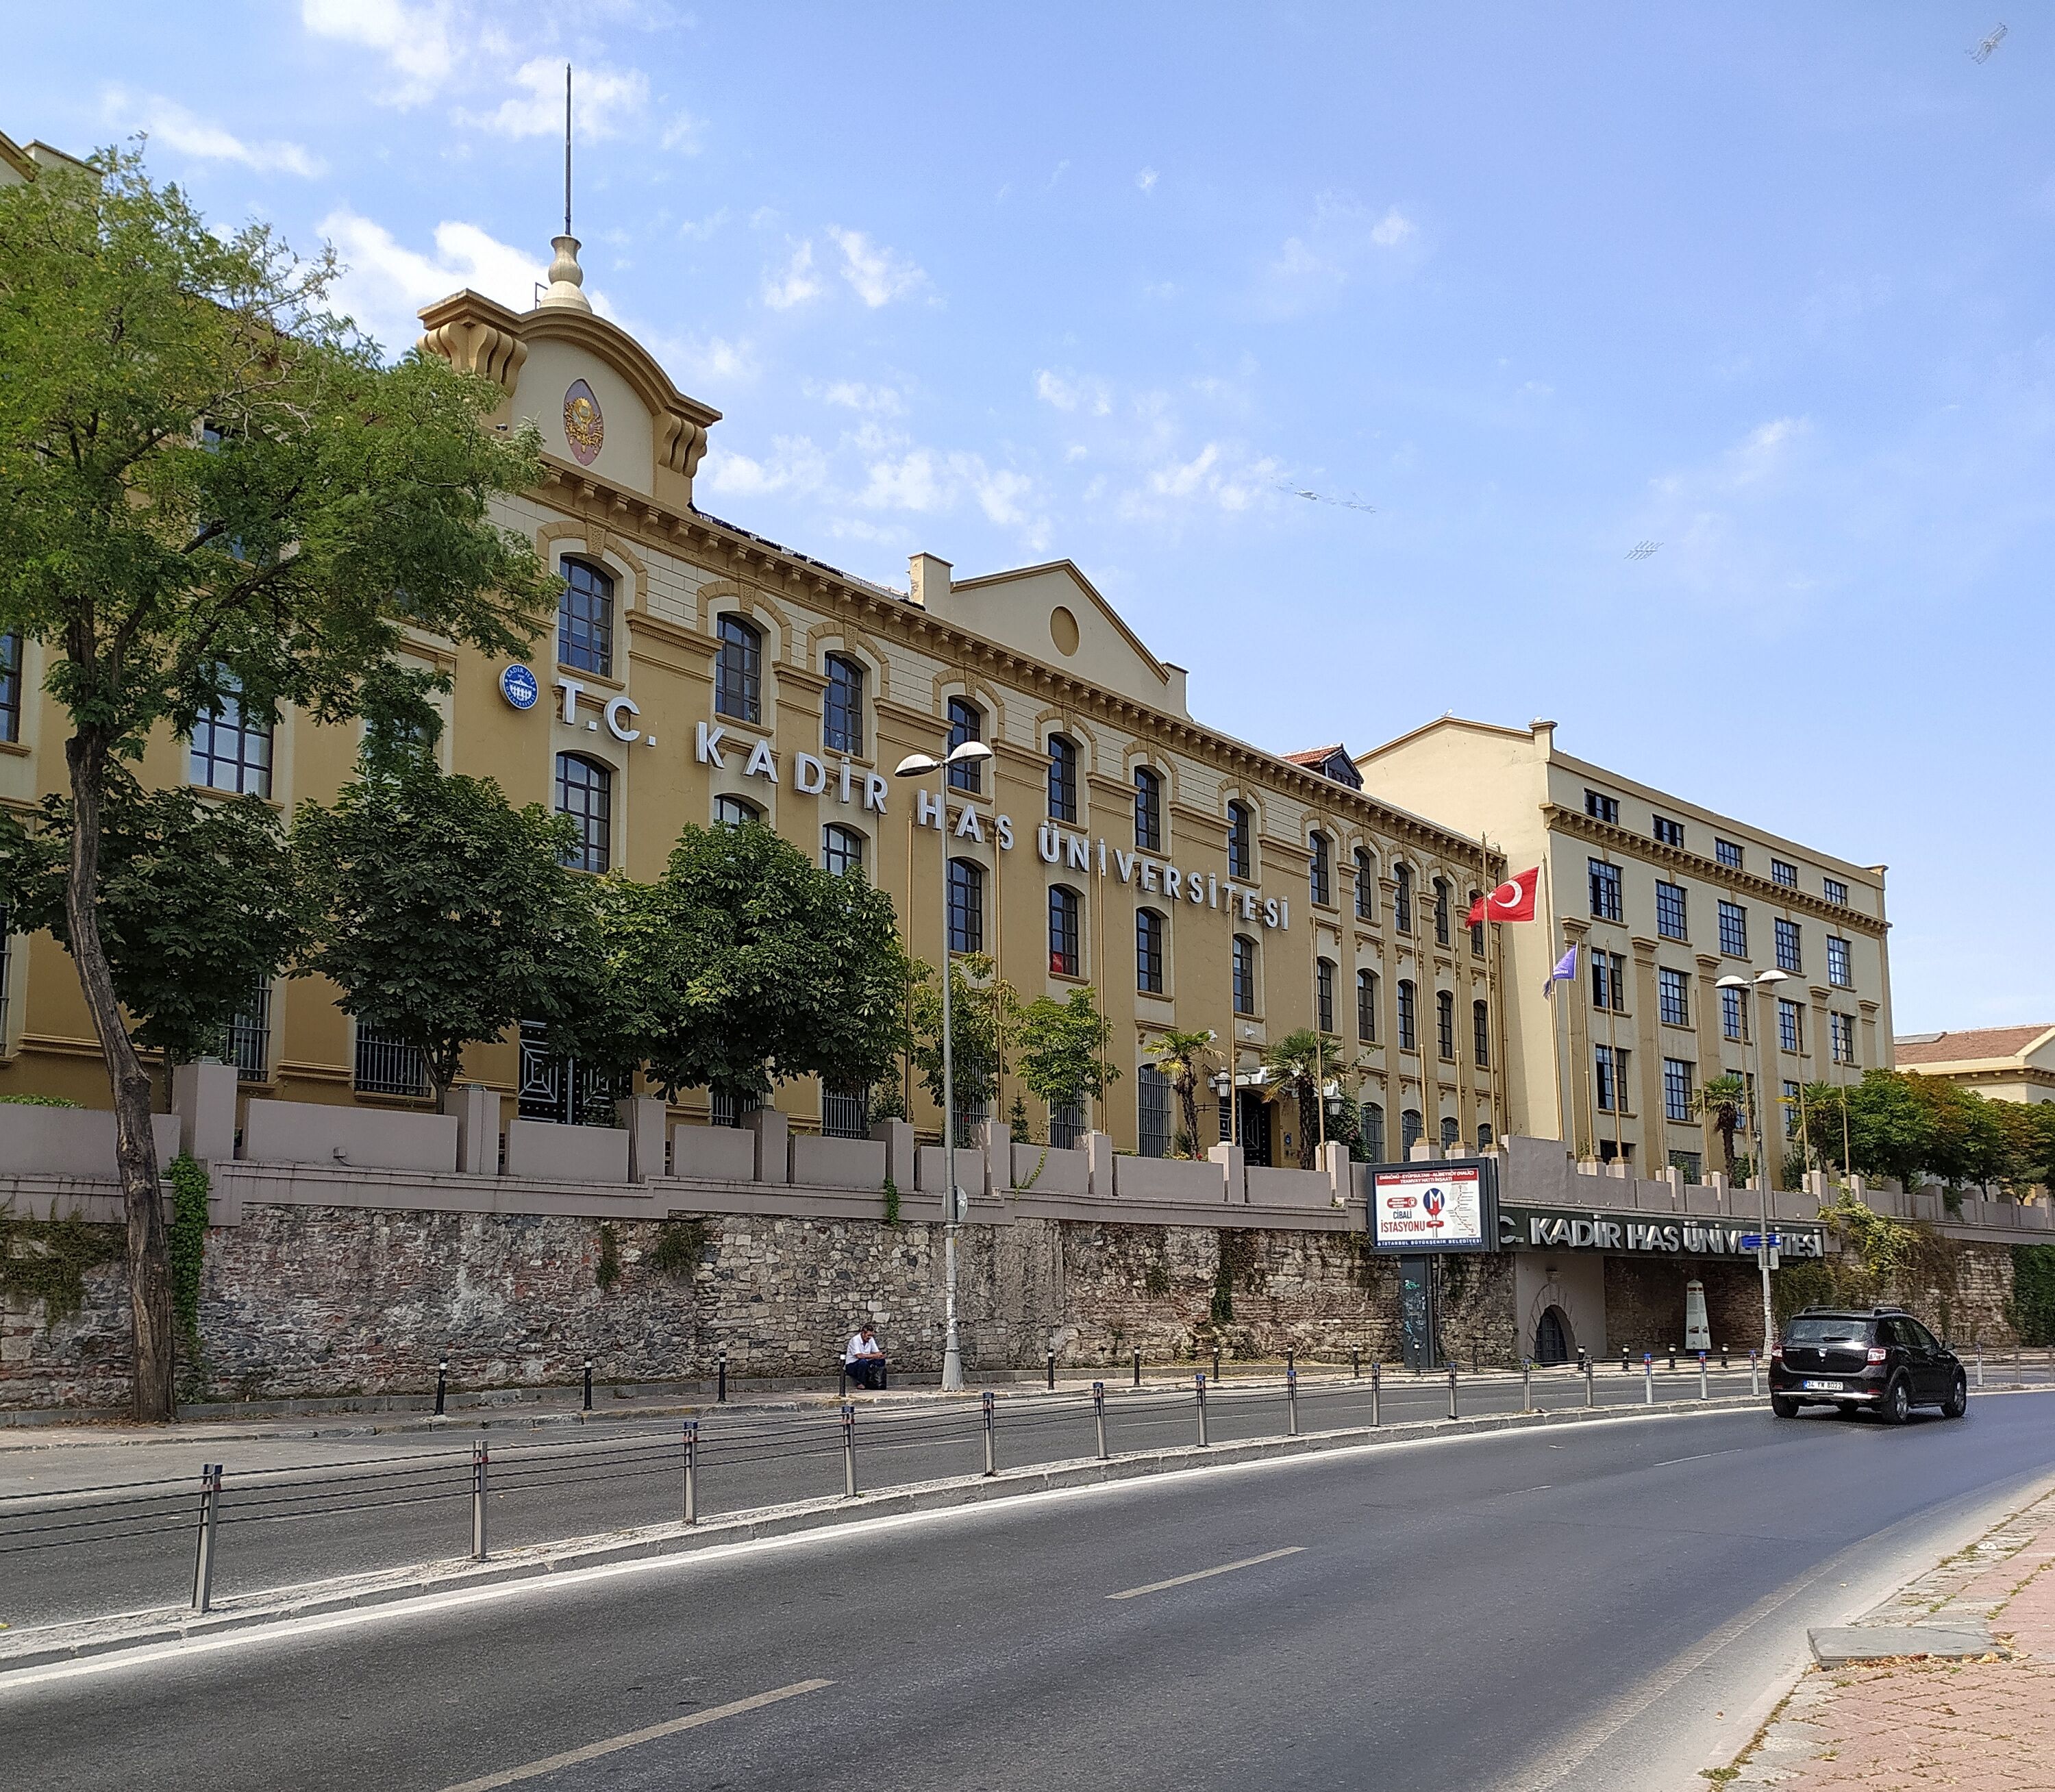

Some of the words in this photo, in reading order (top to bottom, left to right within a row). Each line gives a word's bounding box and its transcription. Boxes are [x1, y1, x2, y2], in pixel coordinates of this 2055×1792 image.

[558, 677, 656, 747] T.C.
[695, 721, 888, 815] KADİR
[916, 788, 1014, 851] HAS
[1038, 821, 1288, 931] ÜNİVERSİTESİ
[1380, 1219, 1425, 1233] İSTASYONU
[1393, 1208, 1412, 1219] CİBALİ
[1530, 1214, 1621, 1248] KADİR
[1627, 1223, 1679, 1252] HAS
